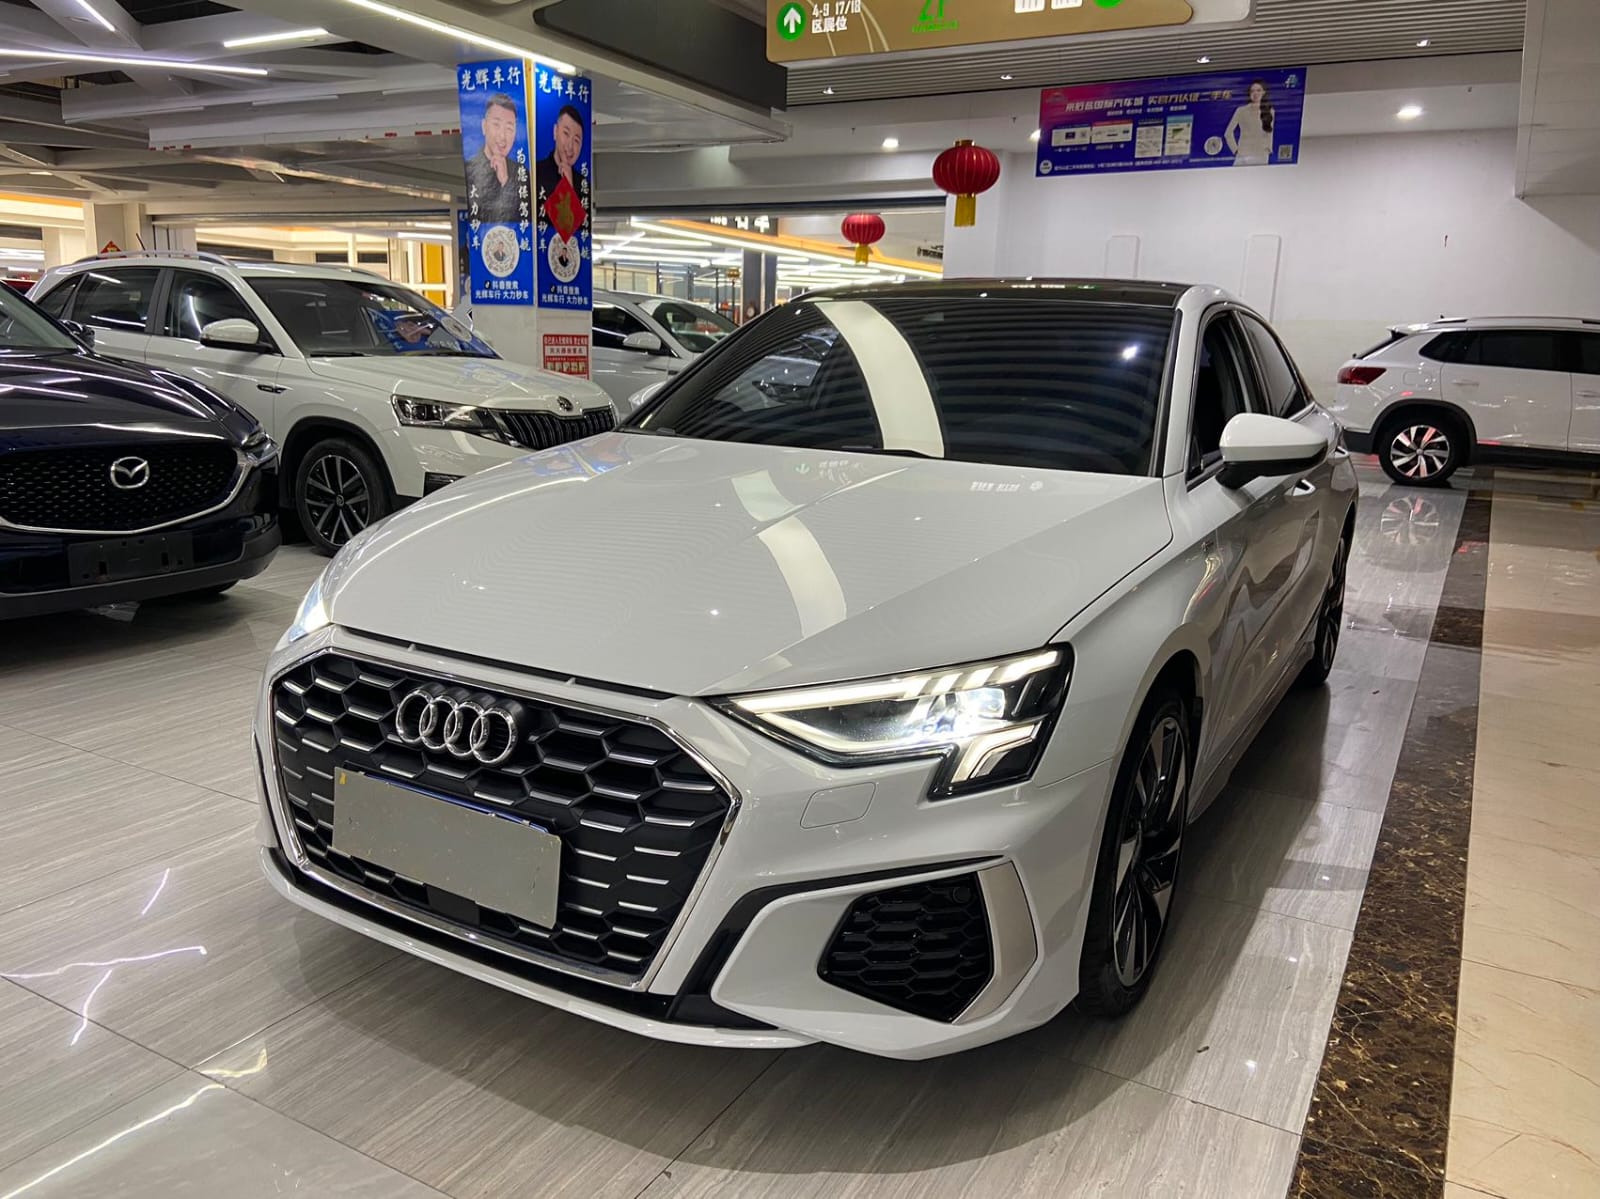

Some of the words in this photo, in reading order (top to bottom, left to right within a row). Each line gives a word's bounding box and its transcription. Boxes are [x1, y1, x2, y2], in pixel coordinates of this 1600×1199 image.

[811, 3, 830, 18] 4-9
[811, 15, 848, 34] 区展位
[469, 184, 481, 250] 大力秒车
[517, 149, 531, 251] 为您保驾护航
